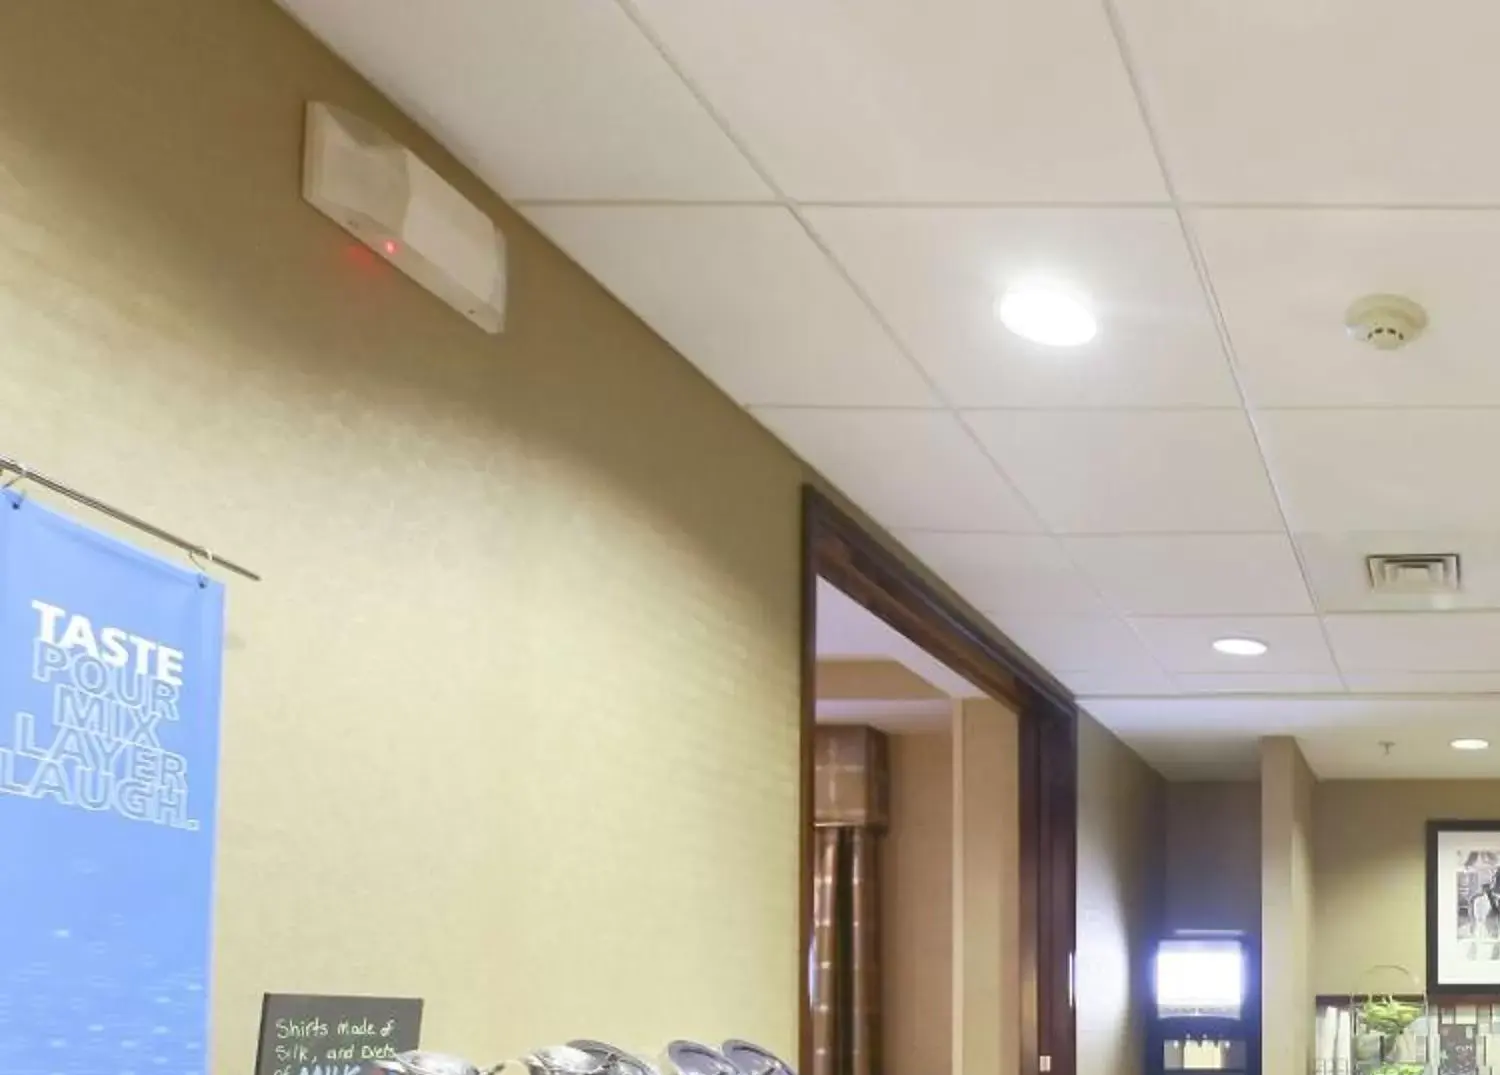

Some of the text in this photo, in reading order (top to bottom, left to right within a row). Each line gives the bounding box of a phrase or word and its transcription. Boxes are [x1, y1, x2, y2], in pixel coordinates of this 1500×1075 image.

[31, 600, 185, 686] TASTE
[32, 638, 180, 721] POUR
[16, 712, 188, 790] LAYER
[53, 683, 160, 751] MIX
[0, 747, 199, 832] LAUGH.
[275, 1017, 329, 1039] Shirts
[326, 1045, 354, 1060] and
